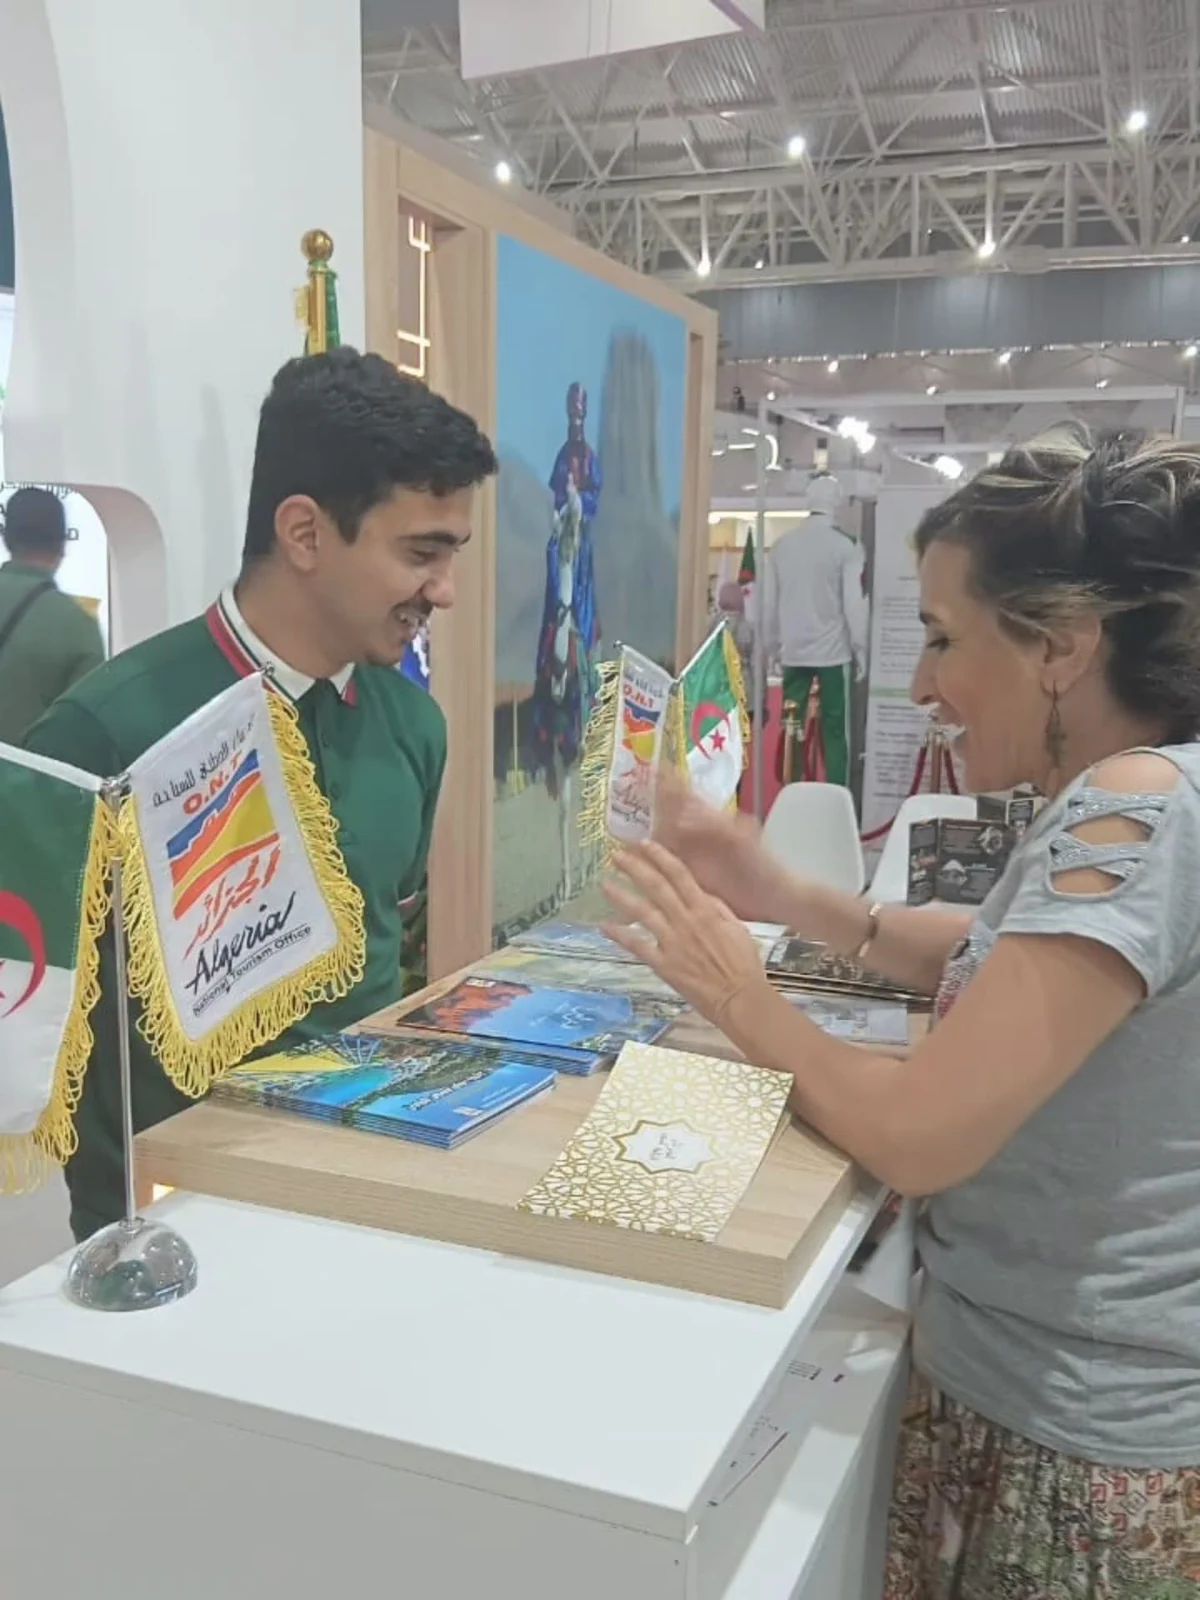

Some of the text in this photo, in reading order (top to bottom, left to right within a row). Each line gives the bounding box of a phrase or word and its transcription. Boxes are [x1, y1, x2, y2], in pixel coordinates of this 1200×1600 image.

[183, 843, 281, 960] الجزائر
[184, 890, 297, 996] Algeria
[193, 925, 312, 1017] National Tourism Office
